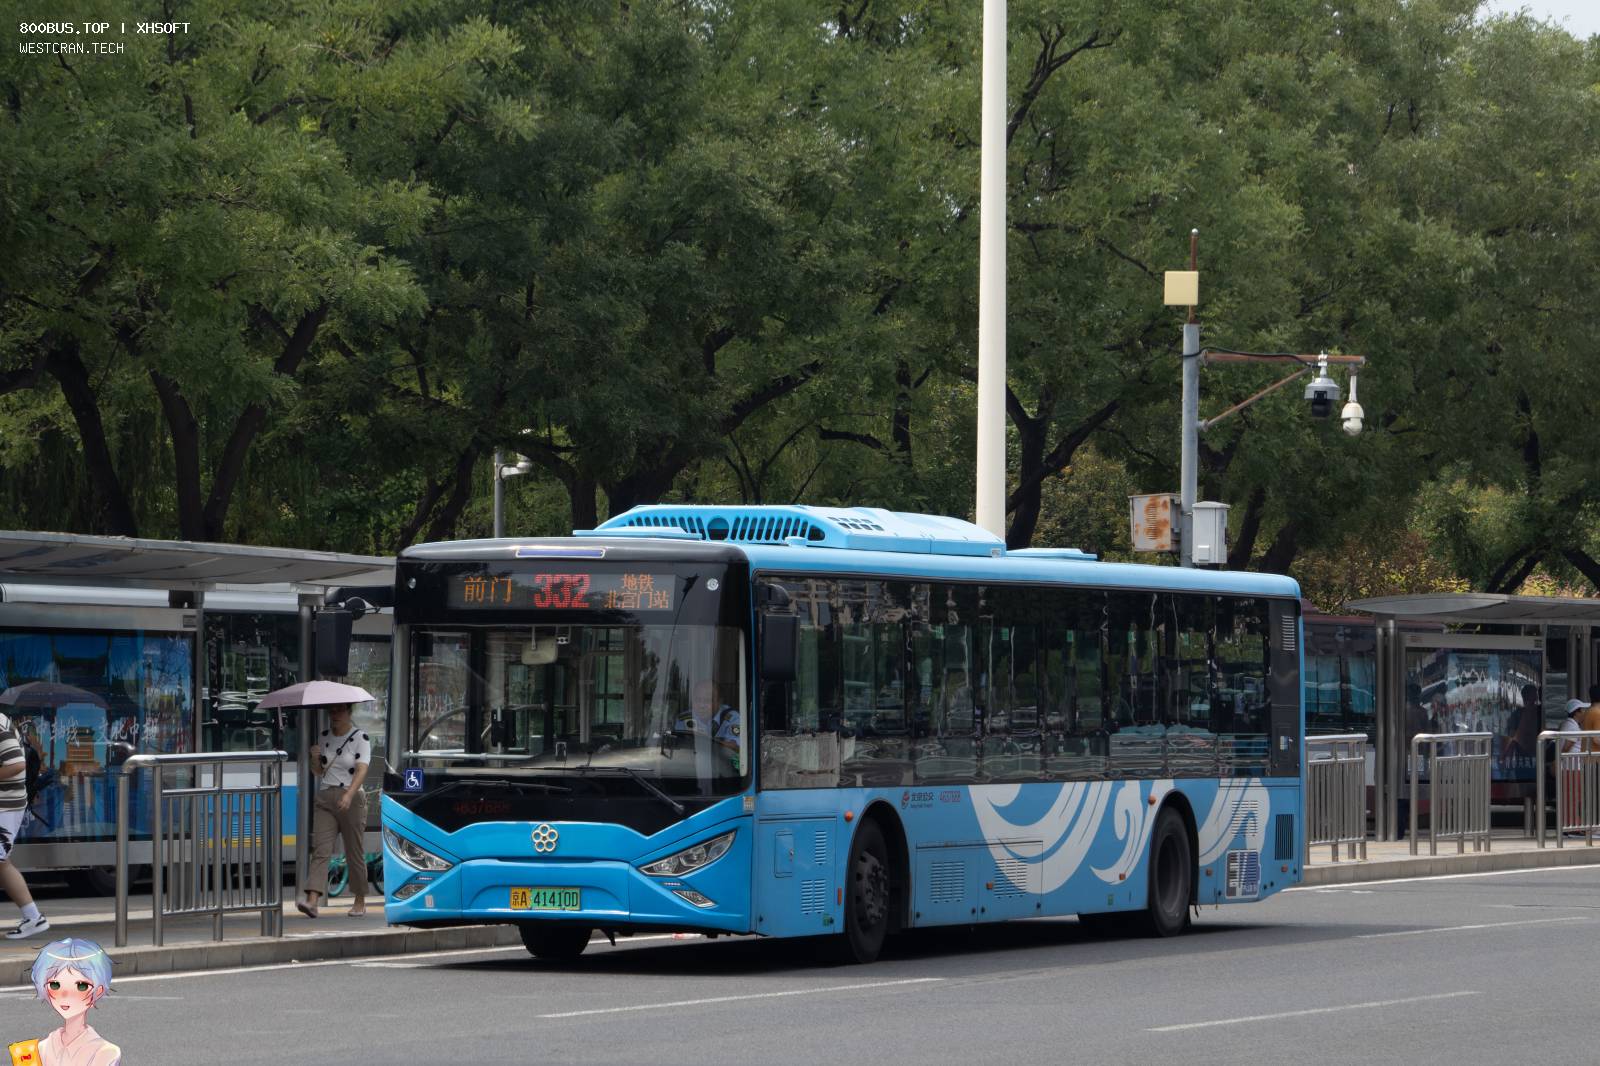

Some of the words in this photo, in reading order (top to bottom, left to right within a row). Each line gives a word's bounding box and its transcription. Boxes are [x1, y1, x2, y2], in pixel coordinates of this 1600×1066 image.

[464, 576, 513, 603] 前门
[534, 573, 591, 609] 332
[621, 573, 655, 591] 地铁
[604, 589, 669, 609] 北宫门站
